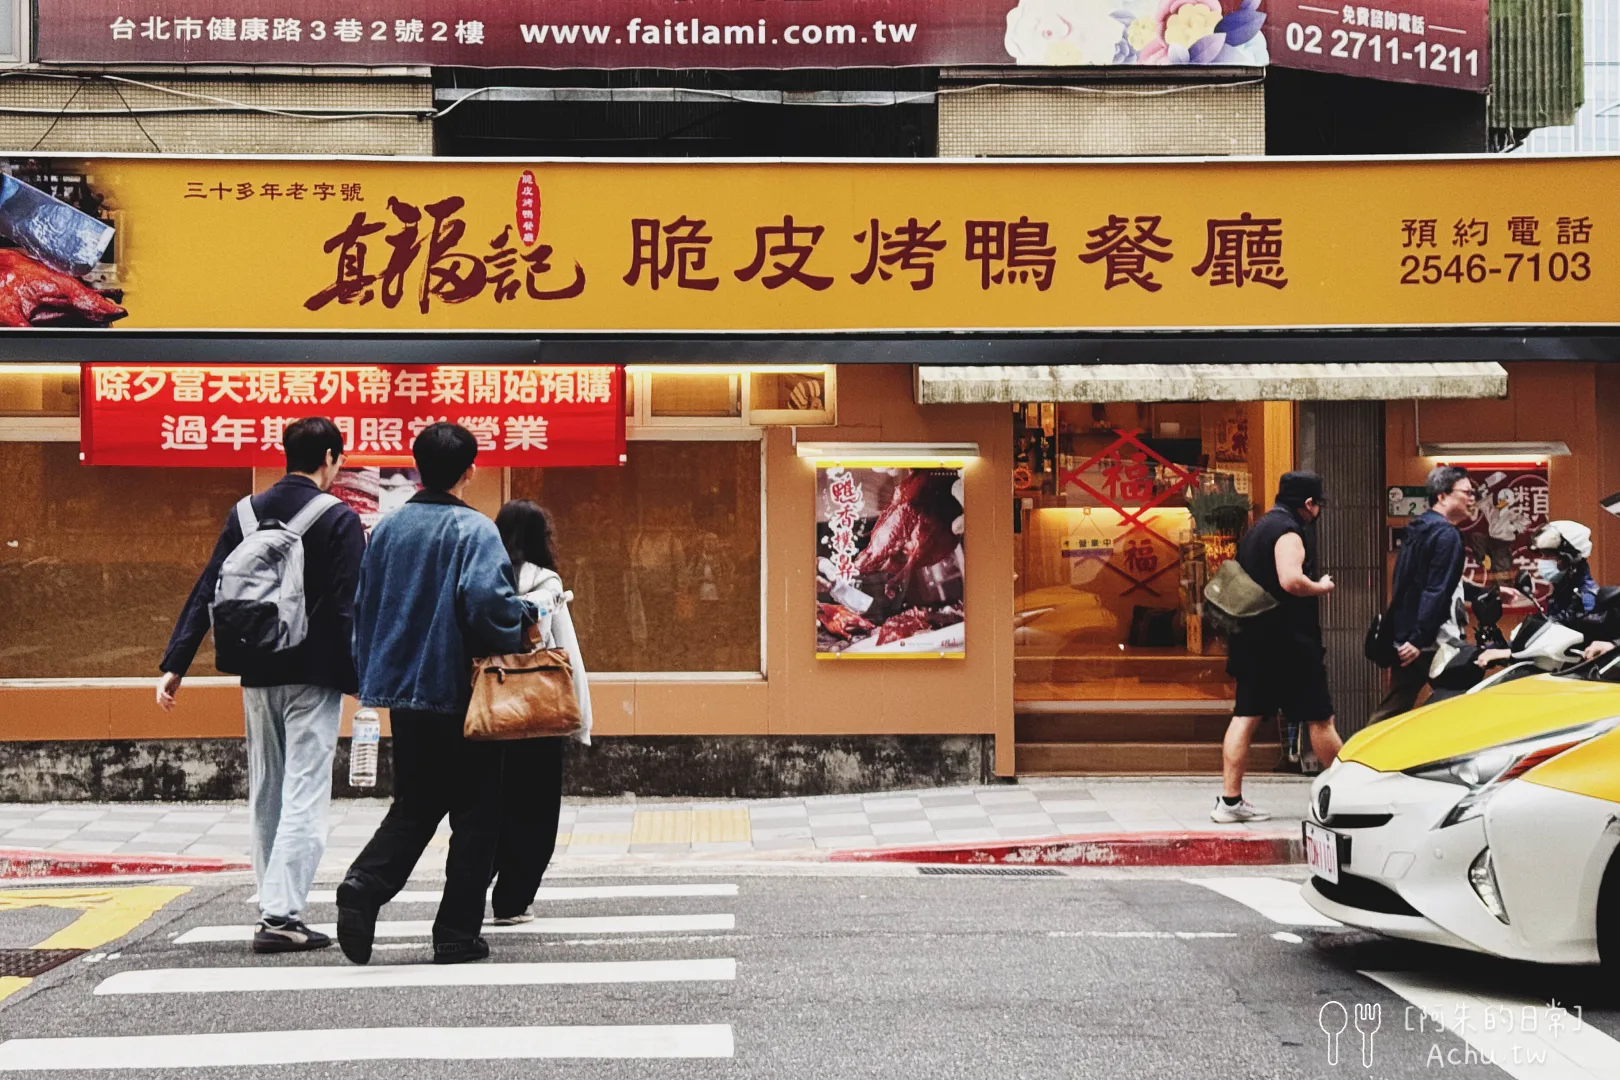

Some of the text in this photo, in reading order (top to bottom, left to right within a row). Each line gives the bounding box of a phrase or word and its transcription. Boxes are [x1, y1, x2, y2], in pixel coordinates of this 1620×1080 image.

[110, 16, 484, 45] 台北市健康路3巷2號2樓
[520, 17, 918, 45] www.faitlami.com.tw
[1286, 22, 1478, 76] 02 2711-1211
[183, 181, 365, 202] 三十多年老字號
[1401, 216, 1593, 248] 預約電話
[303, 195, 586, 315] 真福記
[622, 212, 1288, 293] 脆皮烤鴨餐廳
[1400, 251, 1591, 285] 2546-7103
[95, 367, 612, 405] 除夕當天現煮外帶年菜開始預購
[1101, 450, 1154, 501] 福
